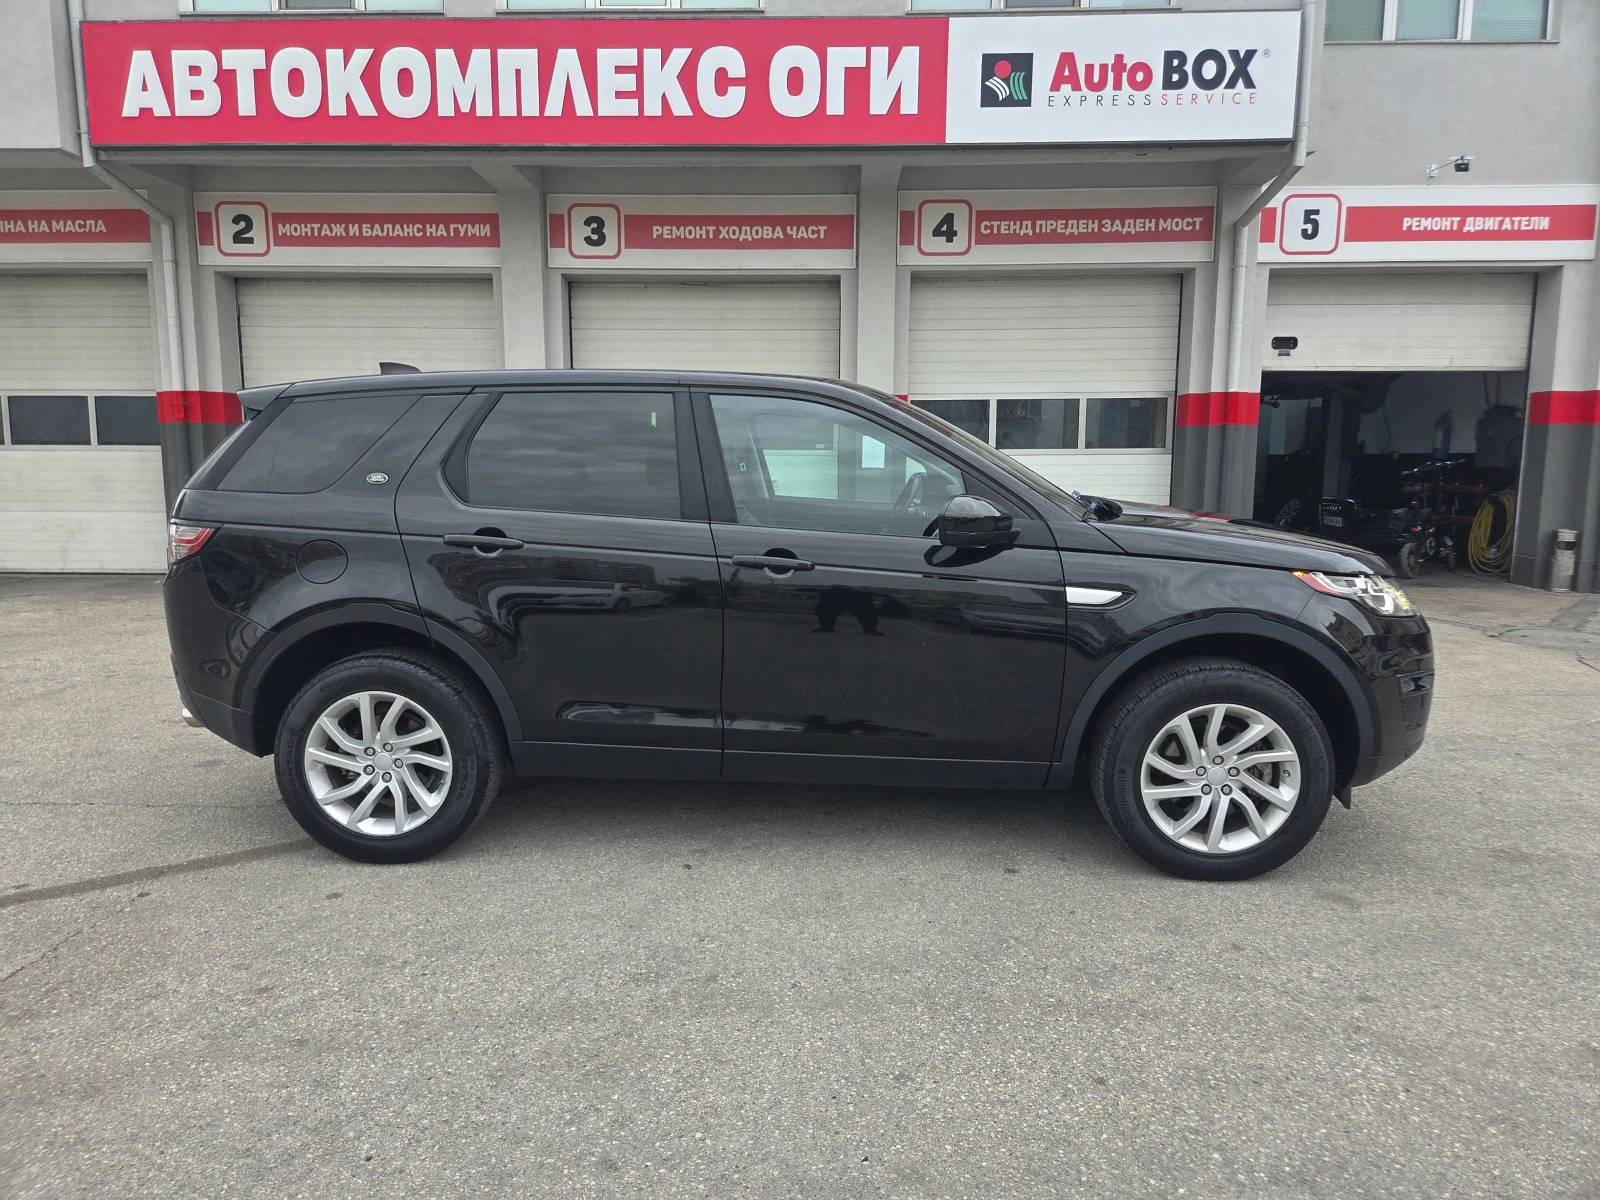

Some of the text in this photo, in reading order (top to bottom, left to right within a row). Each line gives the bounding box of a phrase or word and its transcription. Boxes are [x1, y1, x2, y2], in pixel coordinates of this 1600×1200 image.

[121, 45, 920, 118] АВТОКОМПЛЕКС ОГИ
[1049, 48, 1258, 92] Auto BOX
[1048, 93, 1257, 107] EXPRESS SERVICE
[28, 219, 50, 233] НА
[51, 219, 107, 233] МАСЛА
[231, 213, 491, 245] 2 МОНТАЖ И БАЛАНС НА ГУМИ
[583, 215, 827, 247] 3 РЕМОНТ ХОДОВА ЧАСТ
[931, 212, 1204, 244] 4 СТЕНД ПРЕДЕН ЗАДЕН МОСТ
[1300, 209, 1550, 241] 5 РЕМОНТ ДВИГАТЕЛИ
